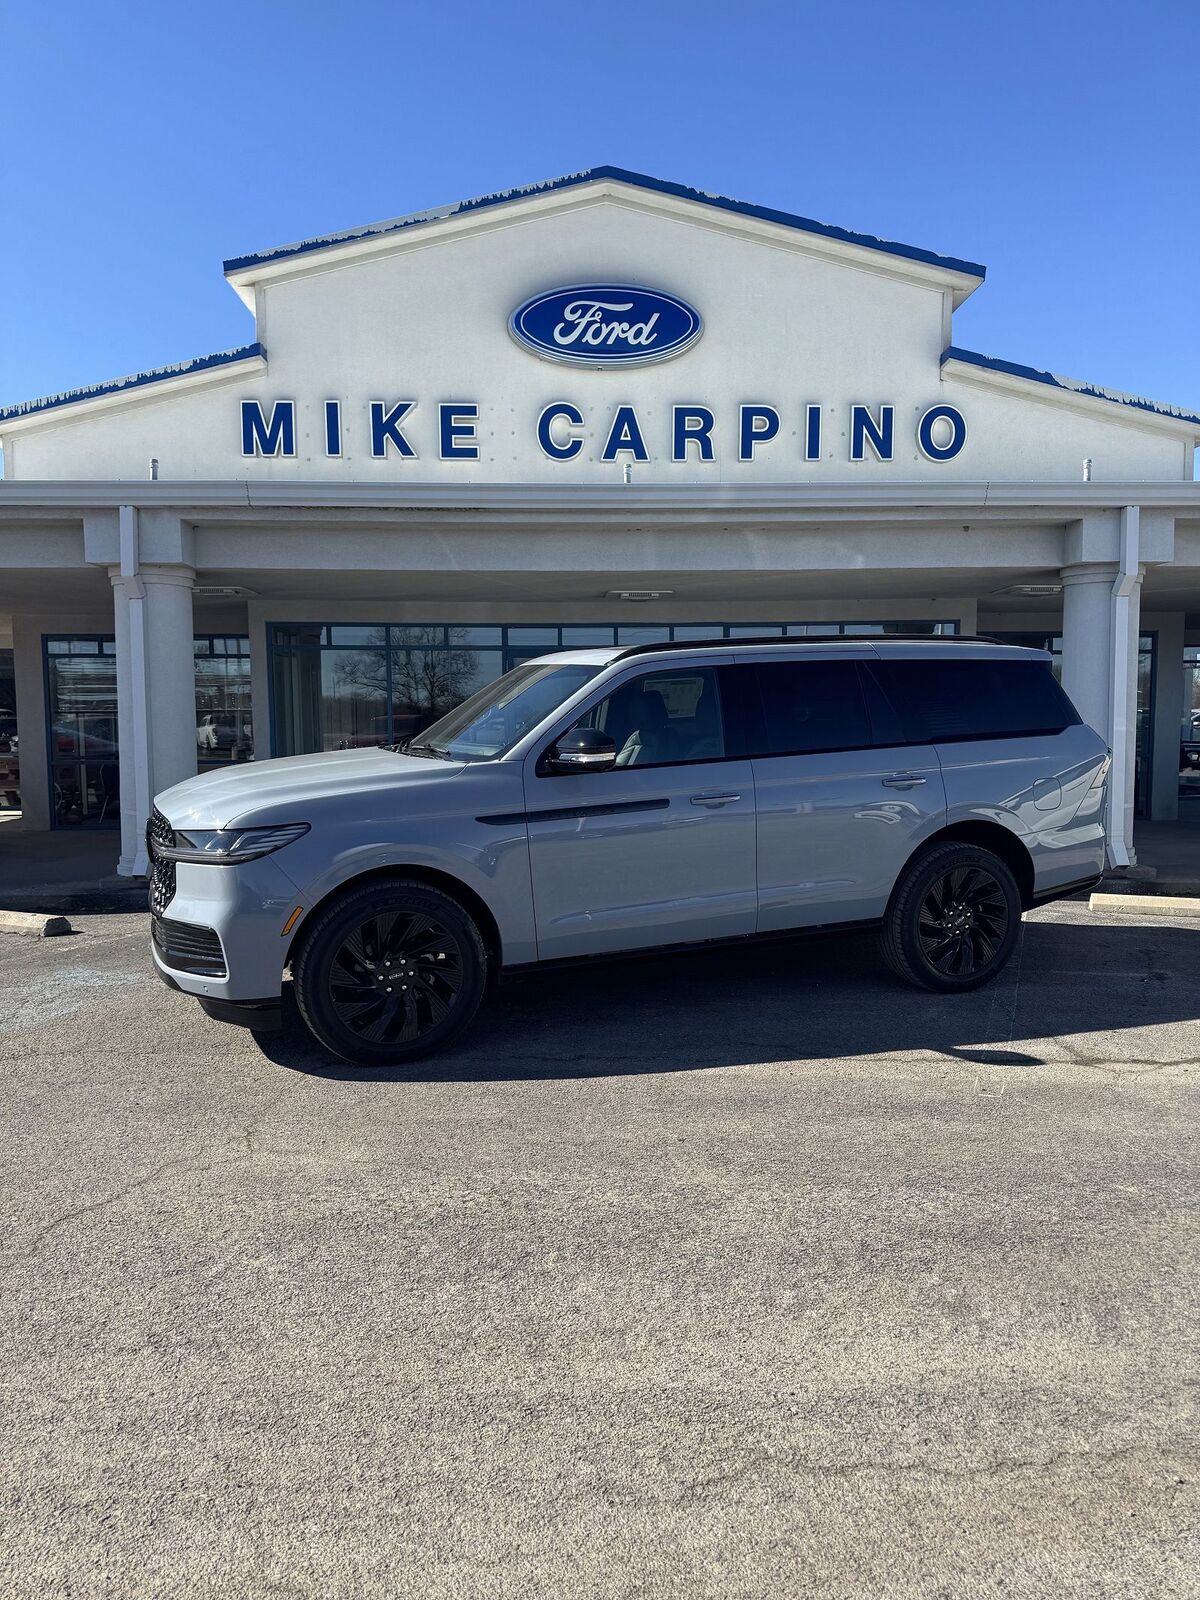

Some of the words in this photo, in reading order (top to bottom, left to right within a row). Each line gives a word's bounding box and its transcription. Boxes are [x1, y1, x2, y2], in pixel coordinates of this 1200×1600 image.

[553, 300, 660, 346] Ford
[240, 401, 479, 460] MIKE
[537, 402, 967, 462] CARPINO
